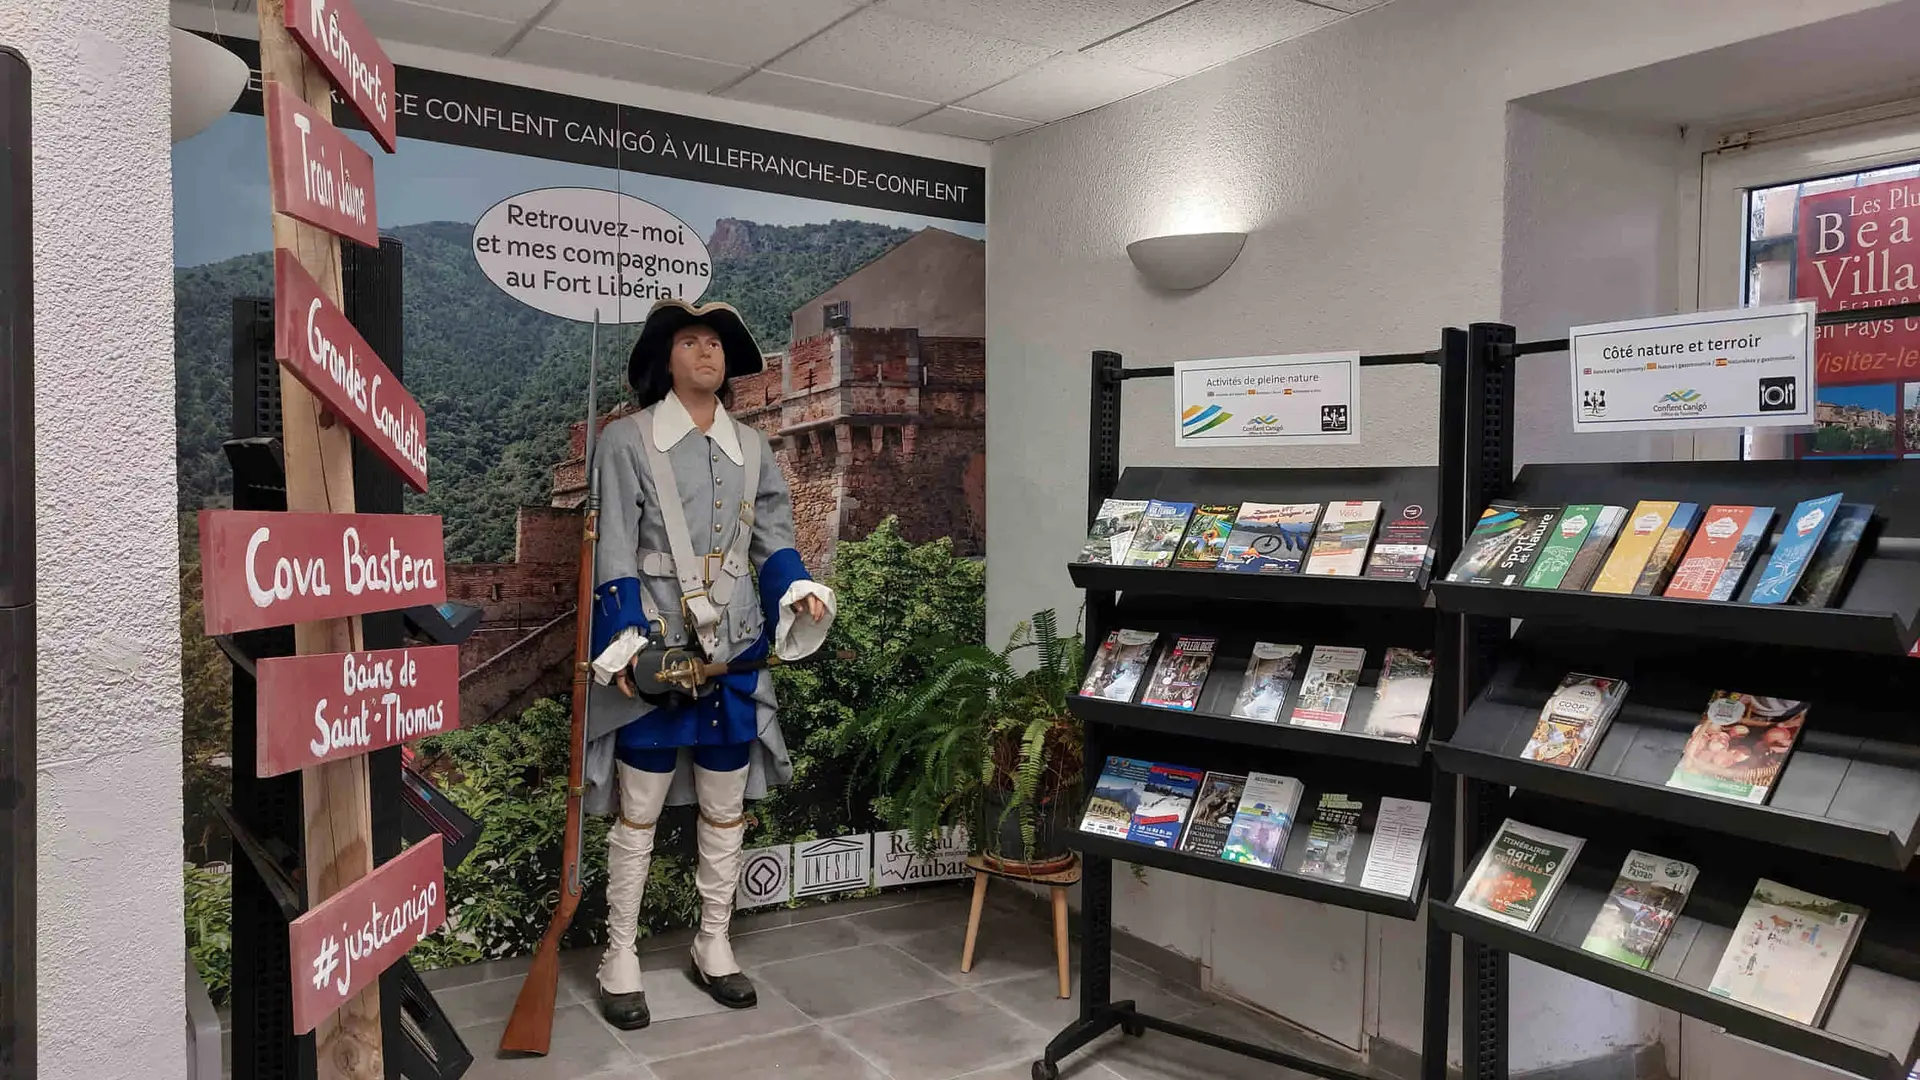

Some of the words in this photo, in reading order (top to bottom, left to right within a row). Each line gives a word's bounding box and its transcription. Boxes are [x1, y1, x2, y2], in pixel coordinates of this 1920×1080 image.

[426, 98, 559, 139] CONFLENT
[564, 121, 656, 155] CANIGÓ
[660, 129, 679, 158] À
[682, 142, 969, 204] VILLEFRANCHE-DE-CONFLENT
[294, 112, 334, 210] Train
[338, 149, 367, 227] Jaune
[1848, 195, 1881, 217] Les
[506, 204, 684, 246] Retrouvez-moi
[476, 236, 501, 254] et
[507, 241, 557, 261] mes
[562, 245, 710, 278] compagnons
[1812, 248, 1918, 299] Villa
[506, 273, 536, 290] au
[543, 268, 592, 295] Fort
[597, 274, 673, 301] Libéria
[1845, 318, 1894, 339] Pays
[1603, 343, 1633, 360] Côté
[1637, 343, 1684, 357] nature
[1688, 340, 1704, 353] et
[1707, 334, 1761, 351] terroir
[1817, 346, 1920, 373] isitez-le
[307, 298, 368, 414] Grandes
[371, 374, 428, 475] Canalettes
[1206, 375, 1242, 388] Activités
[1244, 376, 1255, 386] de
[1257, 374, 1286, 387] pleine
[1288, 374, 1320, 383] nature
[1653, 403, 1682, 412] Conflent
[1522, 513, 1554, 551] Nature
[246, 527, 331, 608] Cova
[343, 527, 437, 596] Bastera
[1519, 553, 1530, 563] et
[343, 653, 393, 696] Bains
[400, 649, 417, 688] de
[1503, 836, 1551, 856] ITINÉRAIRES
[1506, 847, 1538, 864] agri
[804, 851, 861, 885] UNESCO
[1494, 853, 1544, 875] culturels
[312, 880, 437, 996] #justcanigo
